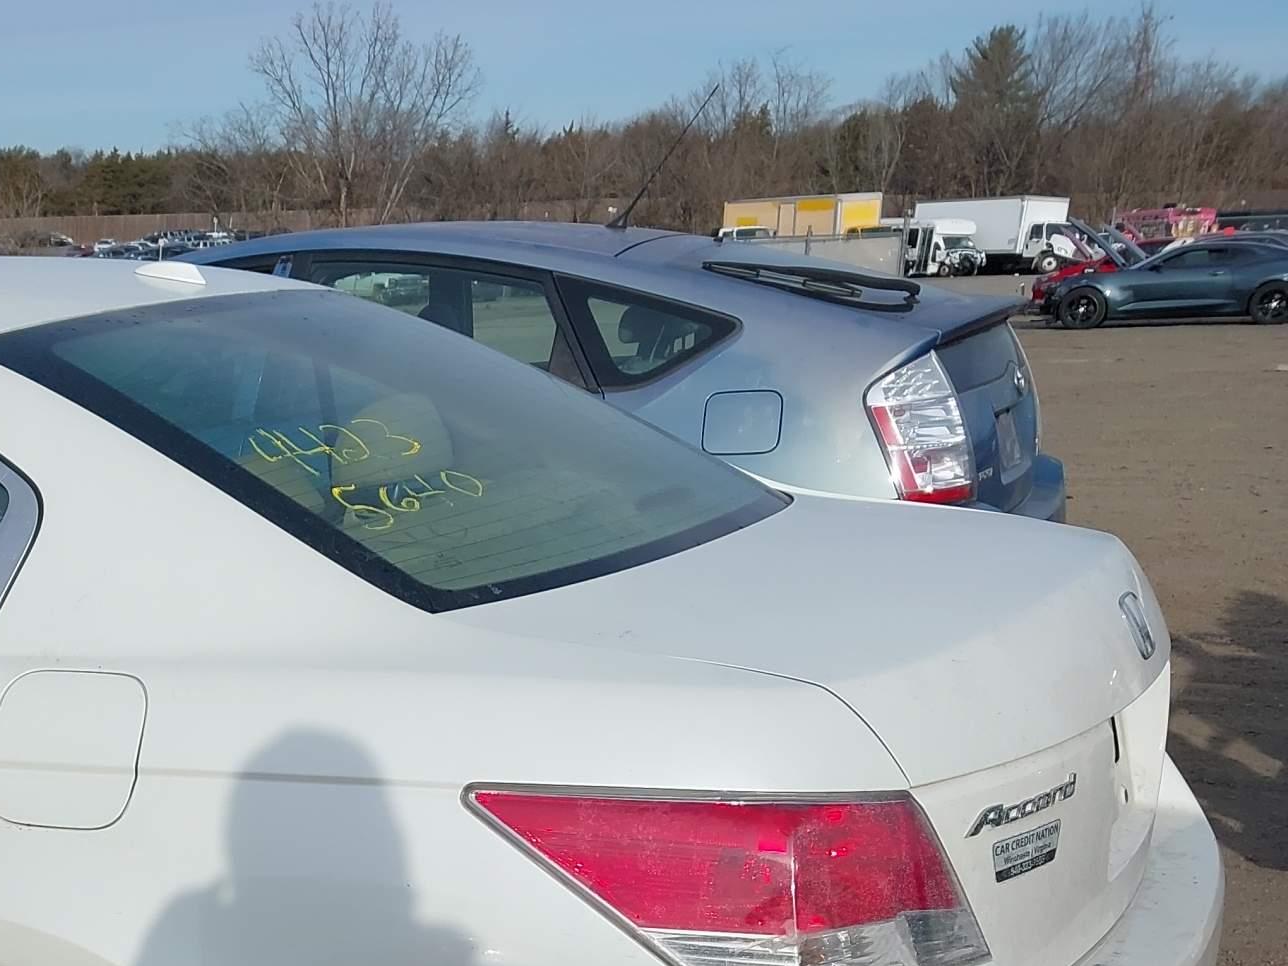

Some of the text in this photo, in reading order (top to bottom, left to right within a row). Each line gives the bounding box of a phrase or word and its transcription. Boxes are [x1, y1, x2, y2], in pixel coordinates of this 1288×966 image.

[248, 418, 422, 477] 4423
[331, 470, 484, 530] 5640
[963, 771, 1078, 839] Accord
[994, 822, 1059, 857] CAR CREDIT NATION
